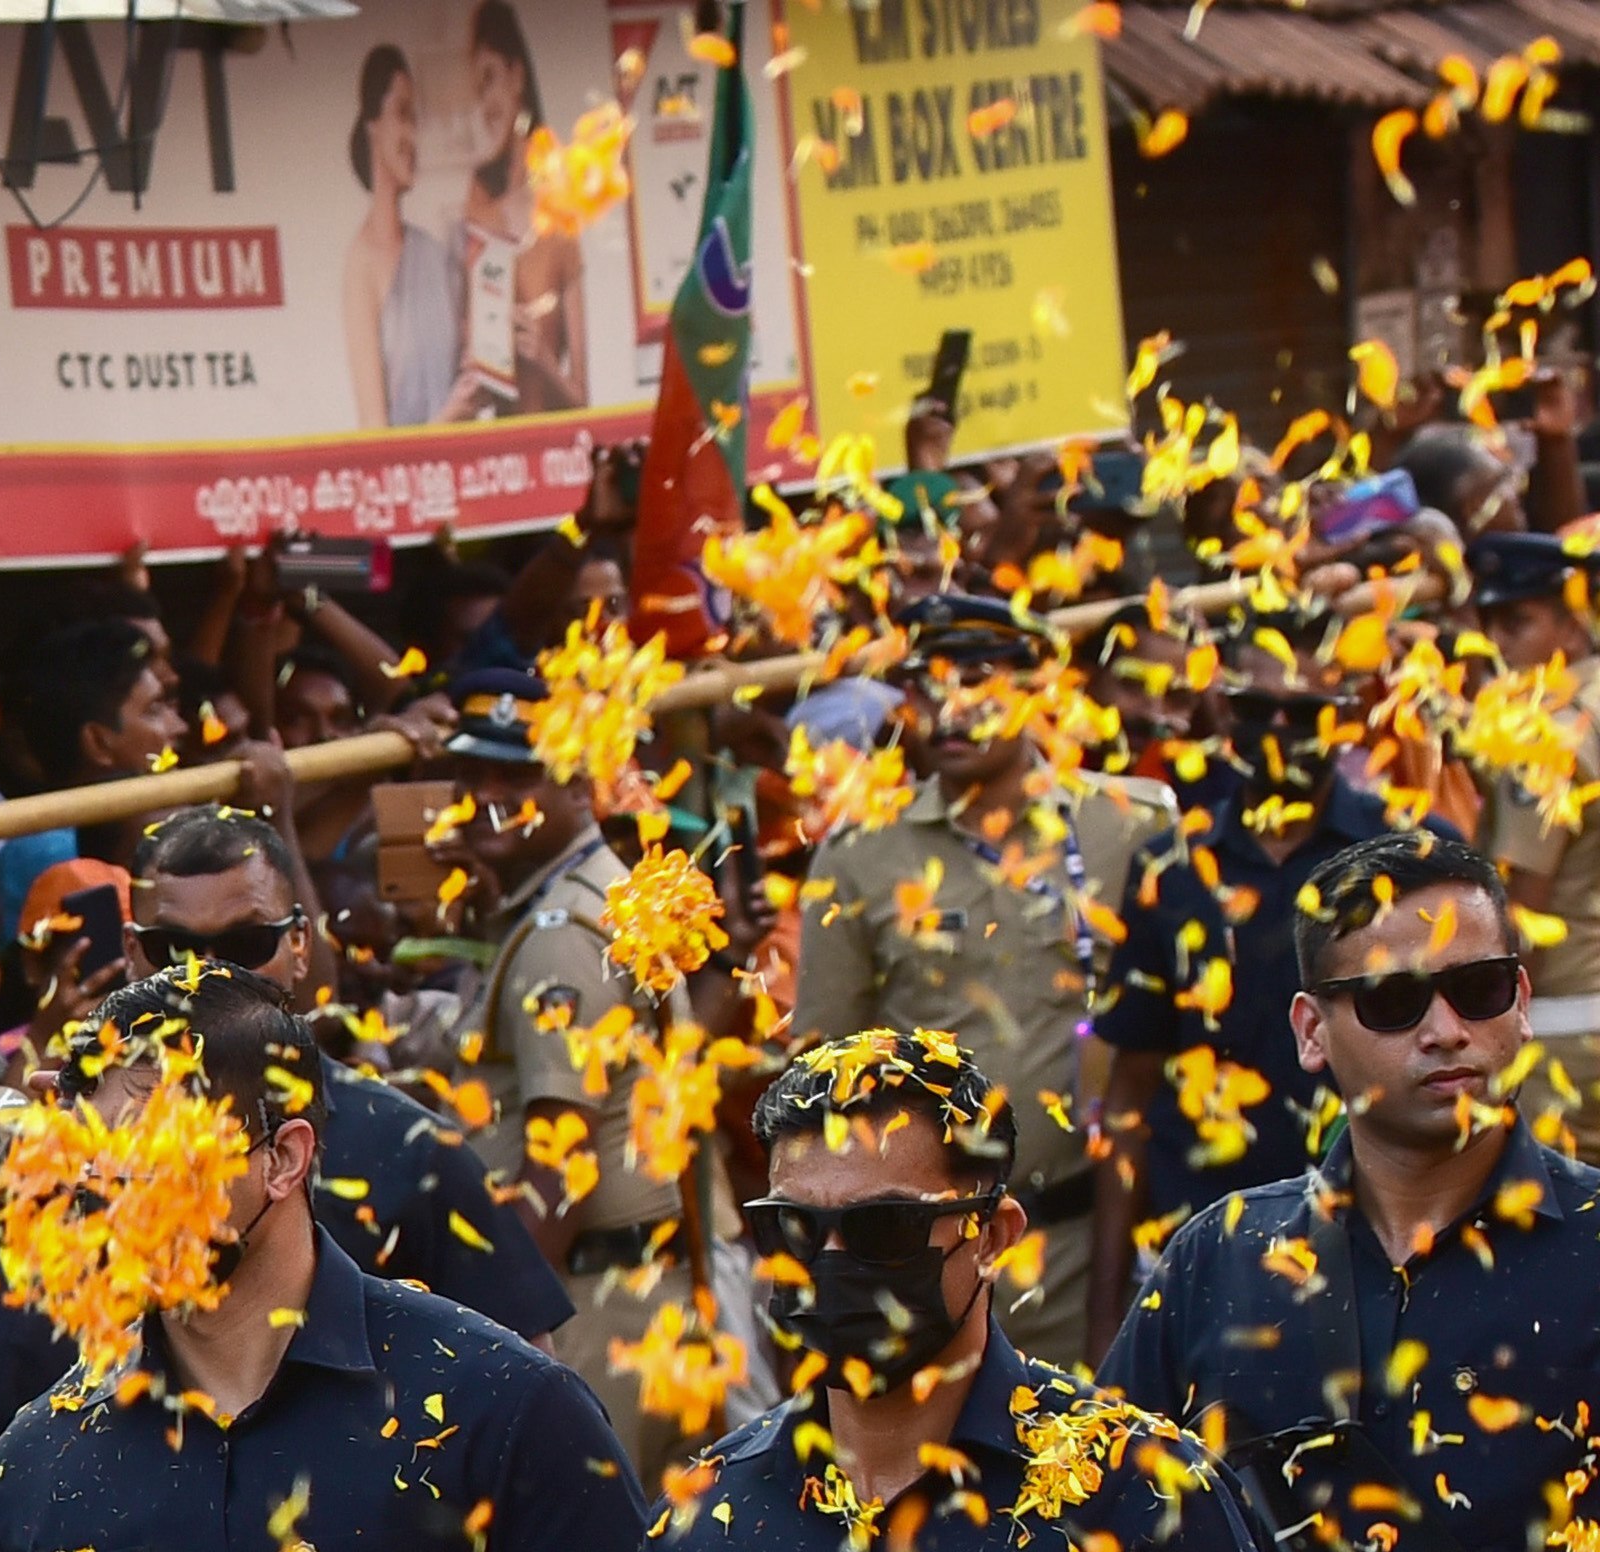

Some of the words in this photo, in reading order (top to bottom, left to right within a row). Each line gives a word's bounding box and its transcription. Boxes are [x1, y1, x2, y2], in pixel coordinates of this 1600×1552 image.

[3, 19, 266, 192] AVT
[26, 237, 266, 299] PREMIUM
[58, 351, 116, 389] CTC
[125, 351, 196, 389] DUST
[204, 350, 257, 387] TEA
